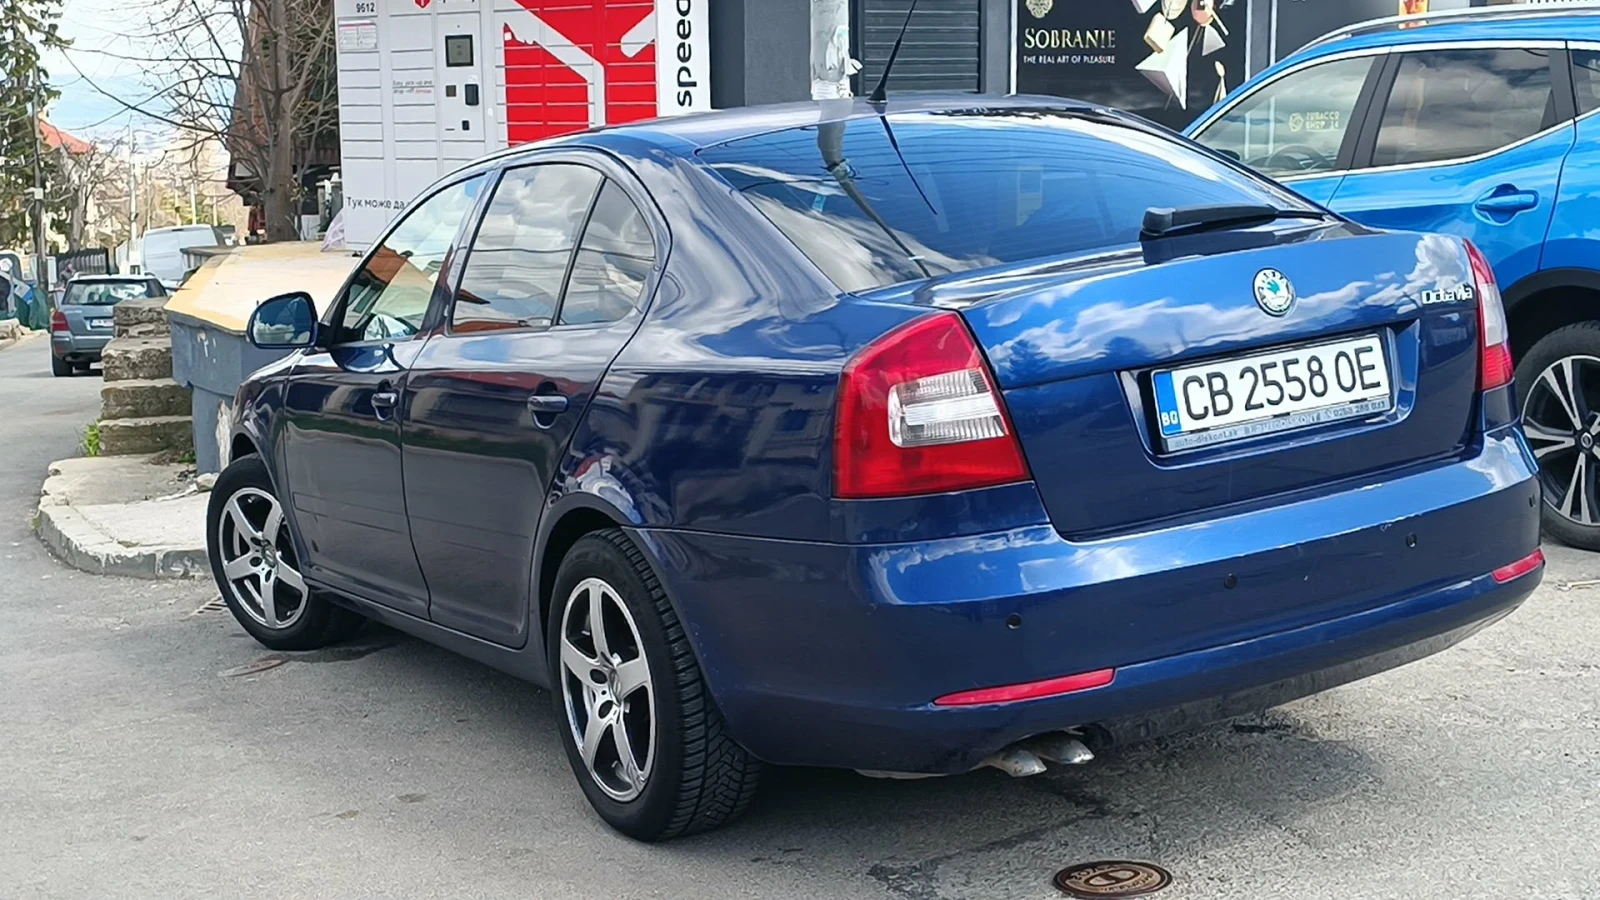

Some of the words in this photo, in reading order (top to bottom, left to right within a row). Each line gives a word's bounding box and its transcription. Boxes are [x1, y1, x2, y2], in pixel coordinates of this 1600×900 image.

[1024, 27, 1116, 49] SOBRANIE
[1023, 55, 1036, 64] THE
[1038, 55, 1055, 64] REAL
[1056, 55, 1070, 64] ART
[1071, 55, 1081, 64] OF
[1083, 55, 1115, 64] PLEASURE
[347, 196, 363, 209] Тук
[364, 199, 392, 209] може
[1182, 370, 1234, 421] CB
[1239, 354, 1329, 412] 2558
[1162, 410, 1179, 426] BG
